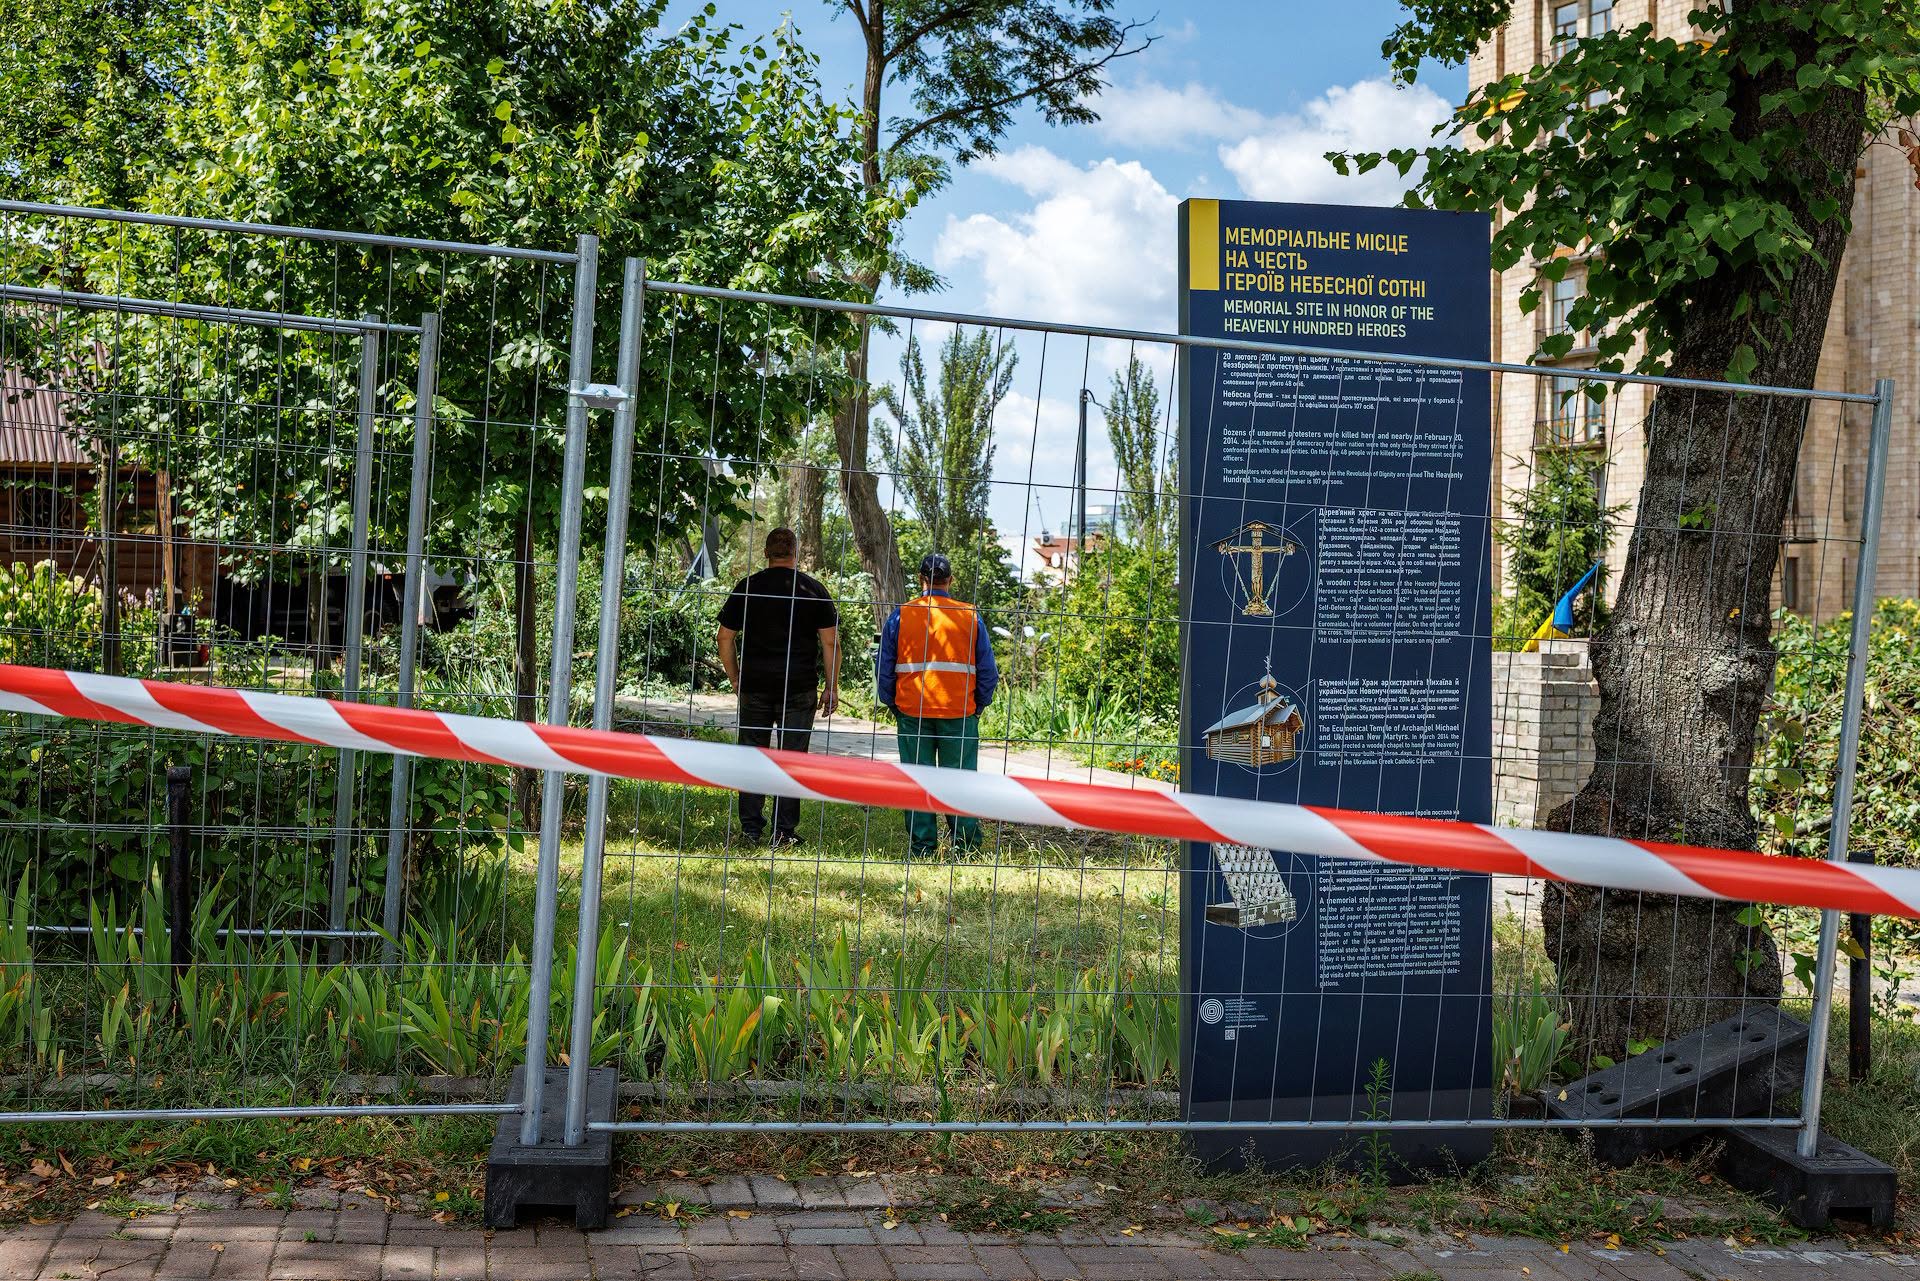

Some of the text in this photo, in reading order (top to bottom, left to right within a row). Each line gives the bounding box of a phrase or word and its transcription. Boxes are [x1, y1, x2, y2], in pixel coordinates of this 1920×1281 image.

[1225, 226, 1408, 256] МЕМОРІАЛЬНЕ МІСЦЕ
[1225, 250, 1308, 270] НА ЧЕСТЬ
[1225, 270, 1426, 298] ГЕРОЇВ НЕБЕСНОЇ СОТНІ
[1224, 300, 1434, 321] MEMORIAL SITE IN HONOR OF THE
[1224, 318, 1406, 338] HEAVENLY HUNDRED HEROES
[1261, 353, 1276, 361] 2014
[1280, 355, 1294, 363] року
[1223, 390, 1250, 399] Небесна
[1254, 391, 1273, 399] Сотня
[1223, 428, 1246, 437] Dozens
[1342, 431, 1359, 439] killed
[1391, 432, 1413, 441] nearby
[1424, 433, 1452, 442] February
[1223, 437, 1240, 445] 2014.
[1424, 470, 1435, 478] The
[1359, 604, 1379, 612] Maidan)
[1362, 679, 1378, 687] Храм
[1319, 724, 1330, 732] The
[1394, 724, 1400, 732] of
[1437, 741, 1459, 749] Heavenly
[1412, 944, 1427, 952] plates
